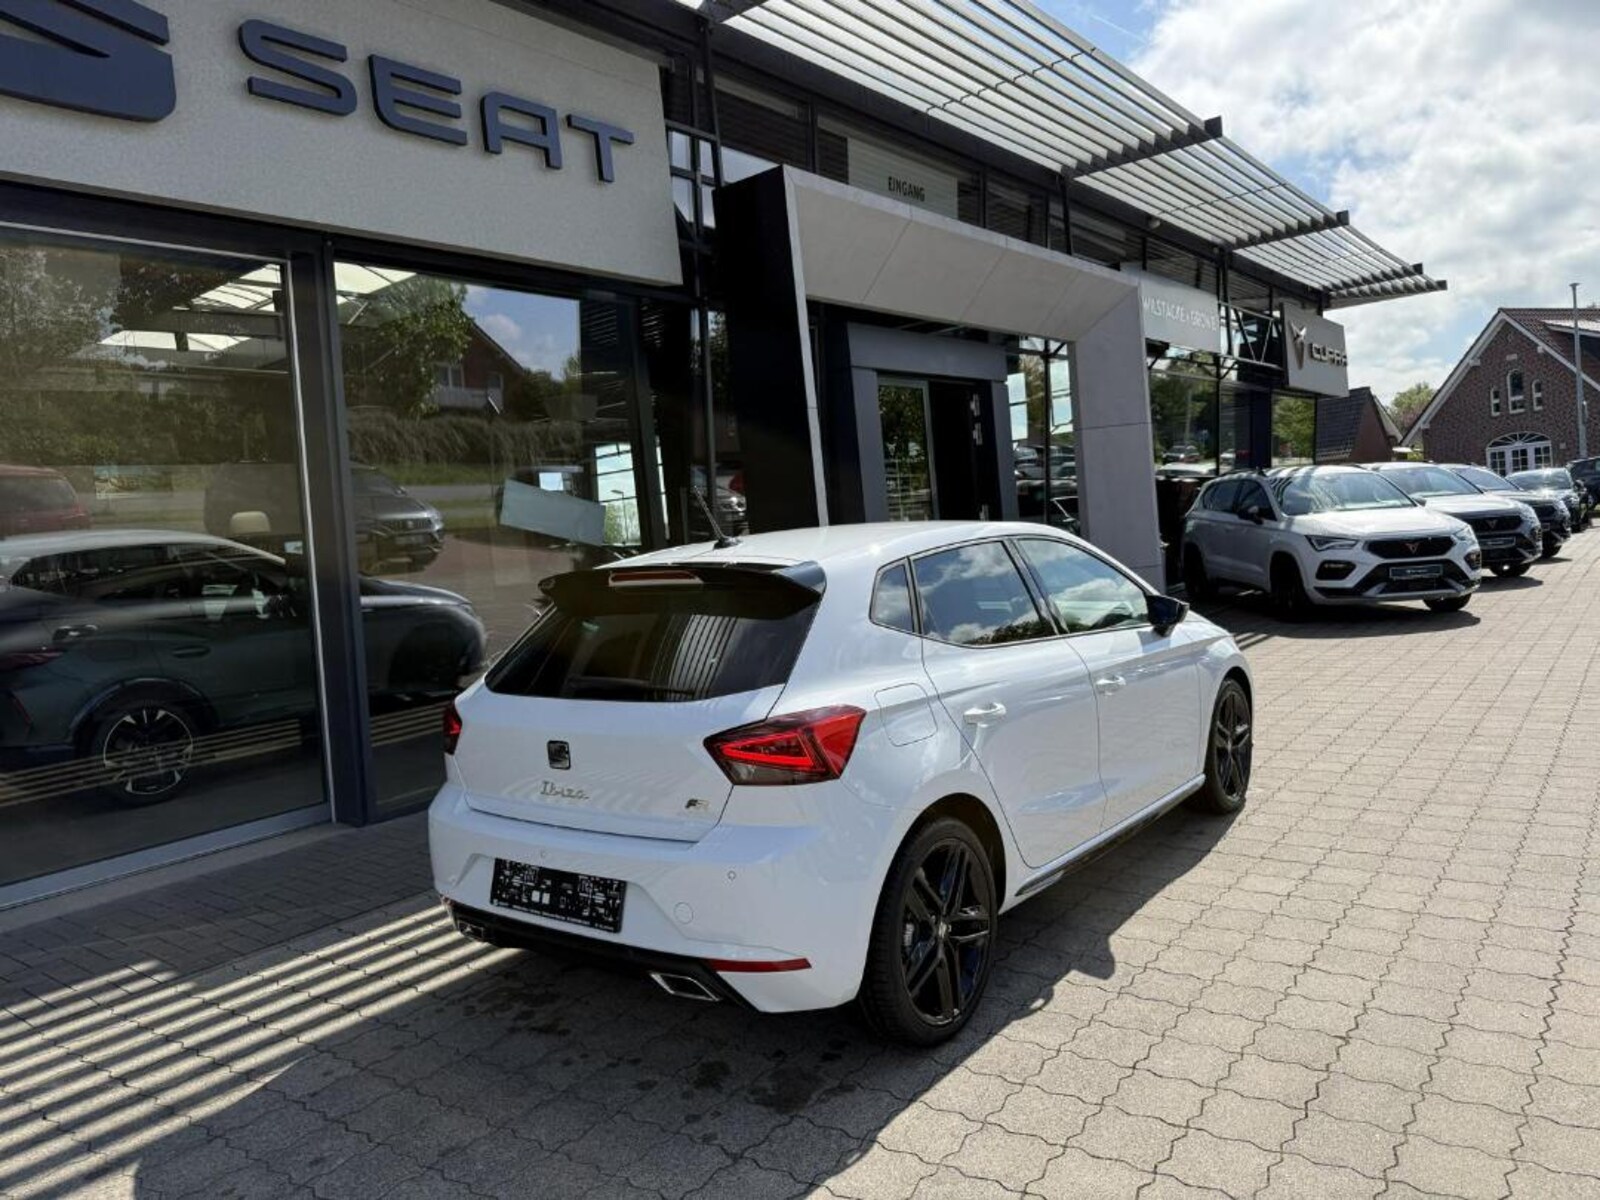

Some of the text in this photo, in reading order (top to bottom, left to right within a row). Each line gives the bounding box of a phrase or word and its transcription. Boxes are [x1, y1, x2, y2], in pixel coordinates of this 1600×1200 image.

[238, 18, 634, 184] SEAT
[887, 176, 926, 202] EINGANG
[540, 780, 590, 800] Ibiza
